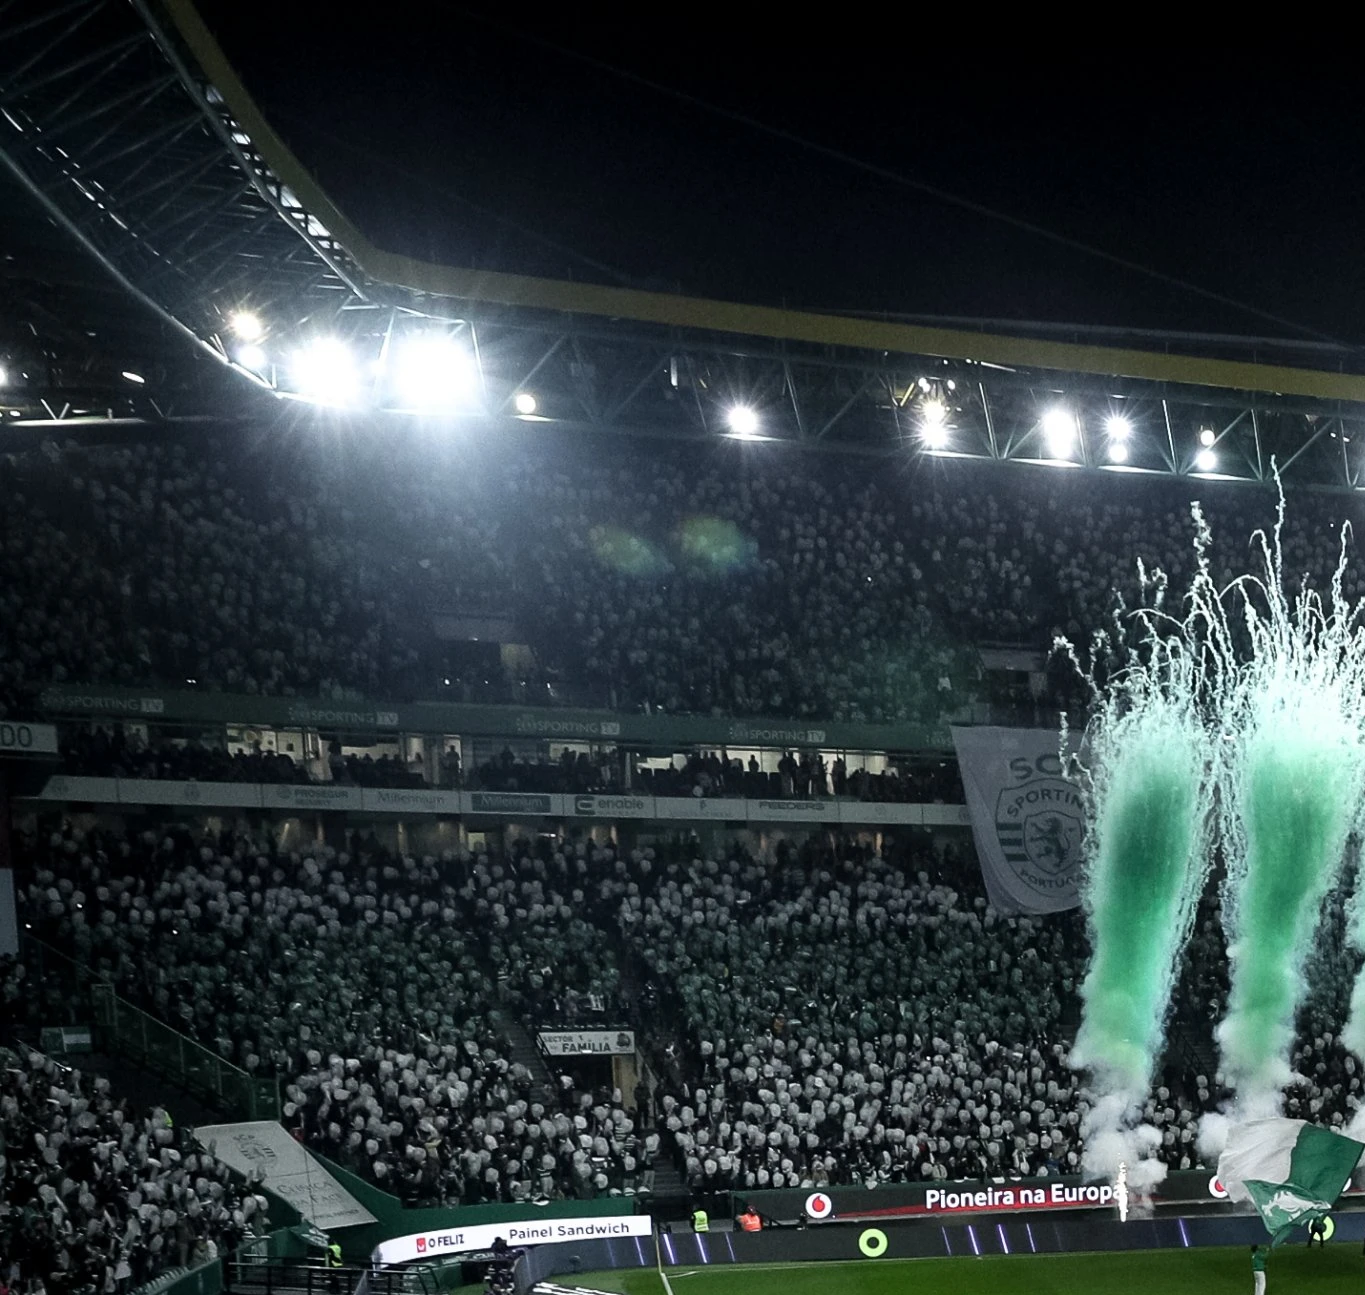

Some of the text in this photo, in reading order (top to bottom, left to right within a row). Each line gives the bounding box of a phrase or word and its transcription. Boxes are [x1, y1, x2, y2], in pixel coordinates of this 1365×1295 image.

[749, 730, 805, 742] SPORTING
[1006, 788, 1085, 817] SPORTIN
[925, 1183, 1121, 1210] Pioneira na Europa
[508, 1222, 630, 1240] Painel Sandwich
[438, 1234, 465, 1248] FELIZ
